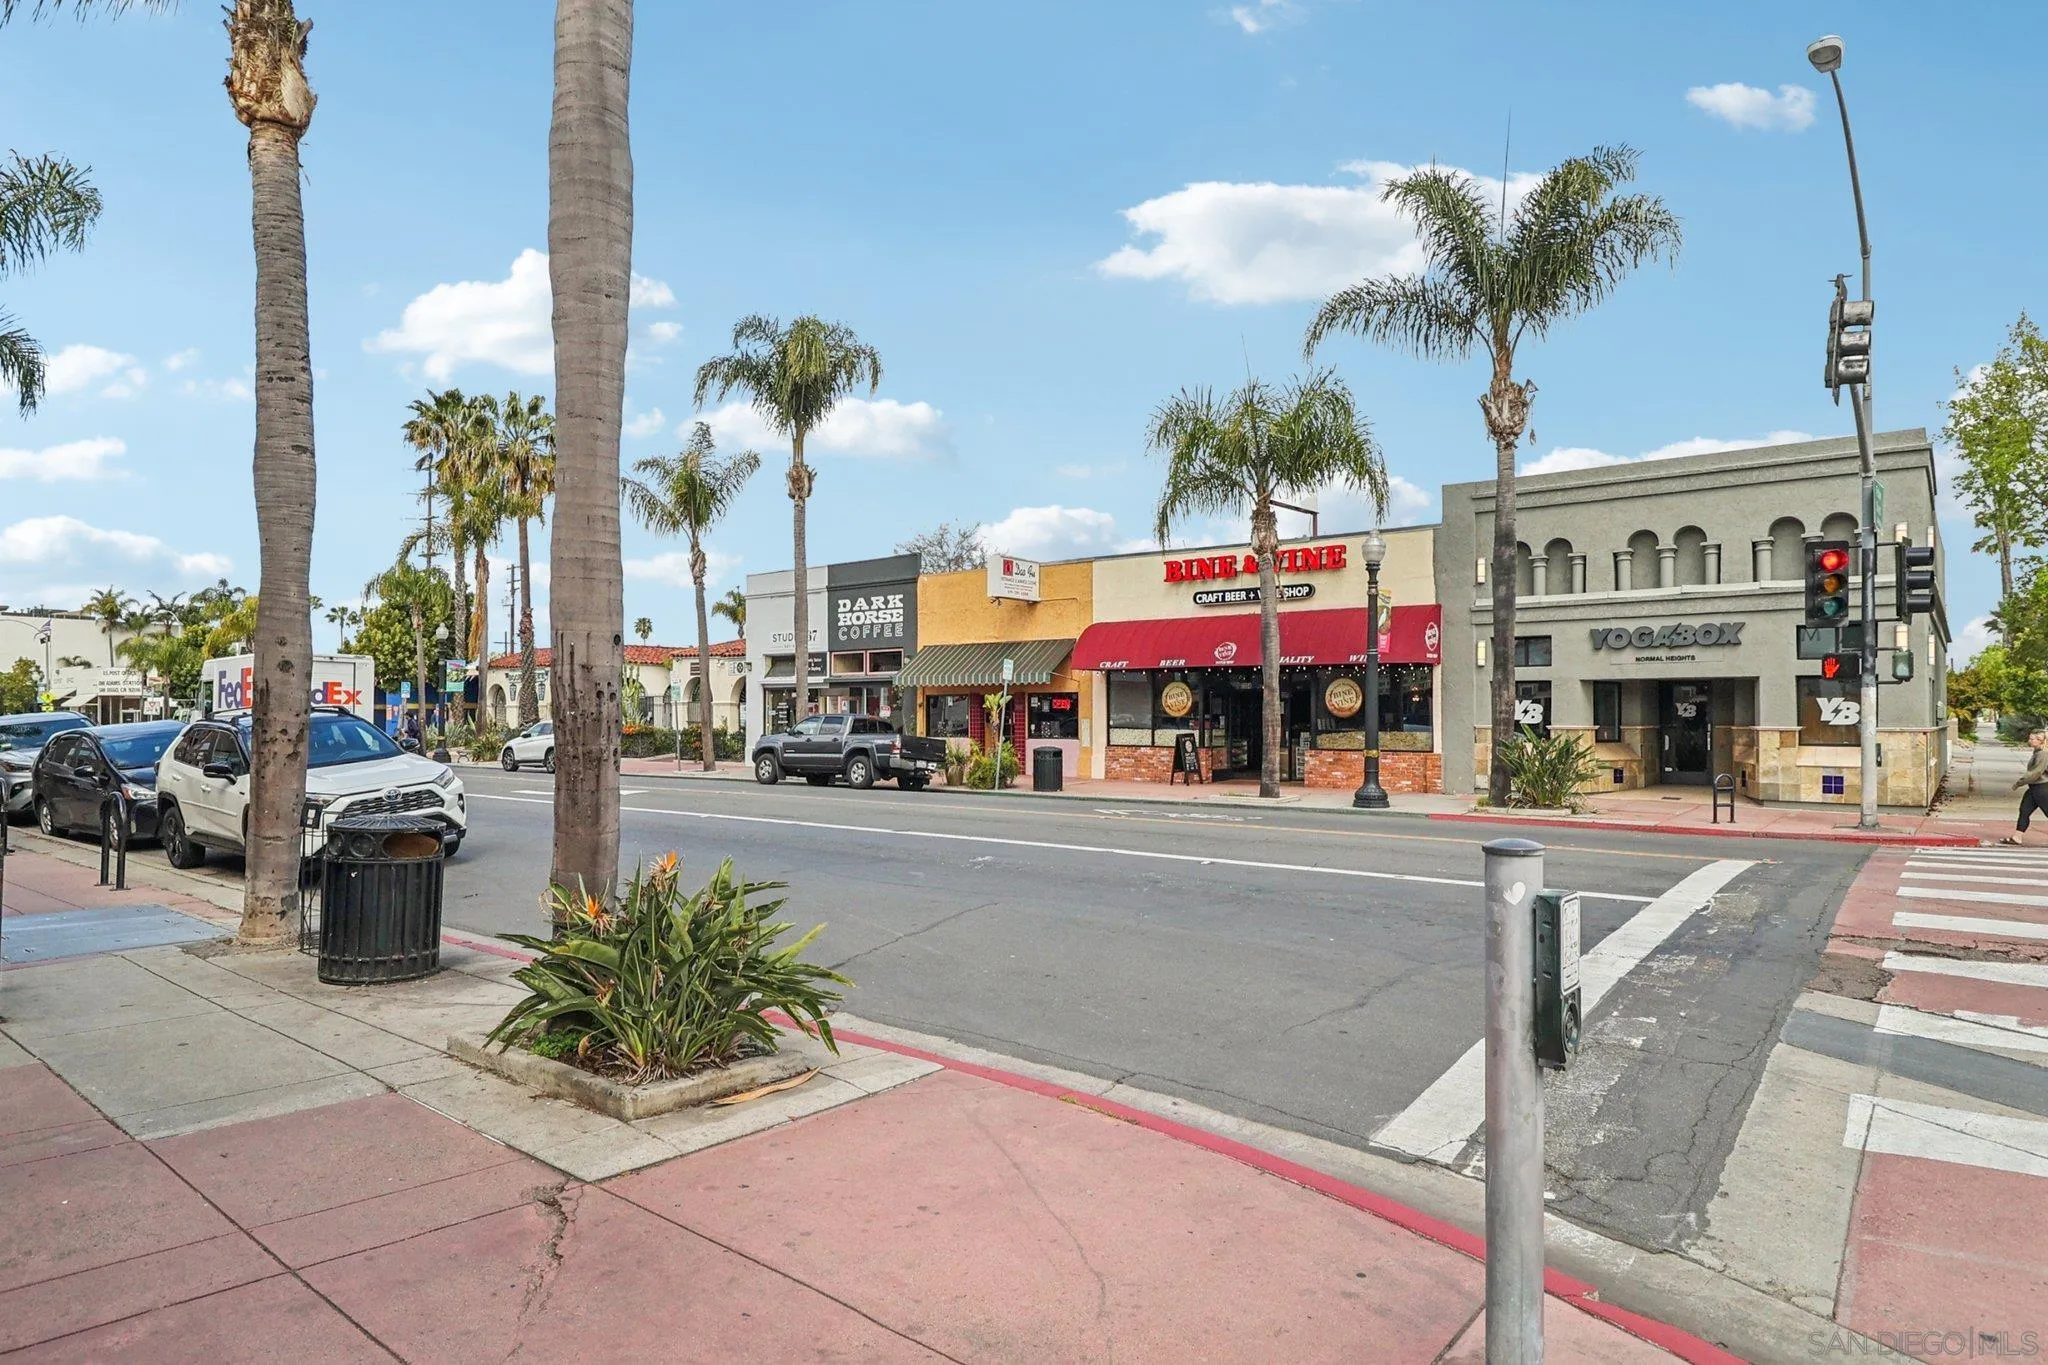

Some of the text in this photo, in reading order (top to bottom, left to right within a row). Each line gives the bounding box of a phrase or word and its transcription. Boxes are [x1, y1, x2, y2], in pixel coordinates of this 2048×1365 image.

[1164, 555, 1238, 582] BINE
[1243, 555, 1259, 573] &
[837, 594, 903, 612] DARK
[1196, 593, 1223, 604] CRAFT
[1225, 588, 1246, 601] BEER
[1283, 586, 1310, 598] SHOP
[837, 608, 903, 626] HORSE
[772, 632, 795, 643] STUD
[838, 622, 903, 641] COFFEE
[1590, 622, 1745, 650] YOGABOX
[1159, 659, 1186, 667] BEER
[218, 667, 253, 709] FedE
[311, 681, 362, 705] dEx
[1675, 702, 1697, 718] YB
[1815, 697, 1861, 725] YB
